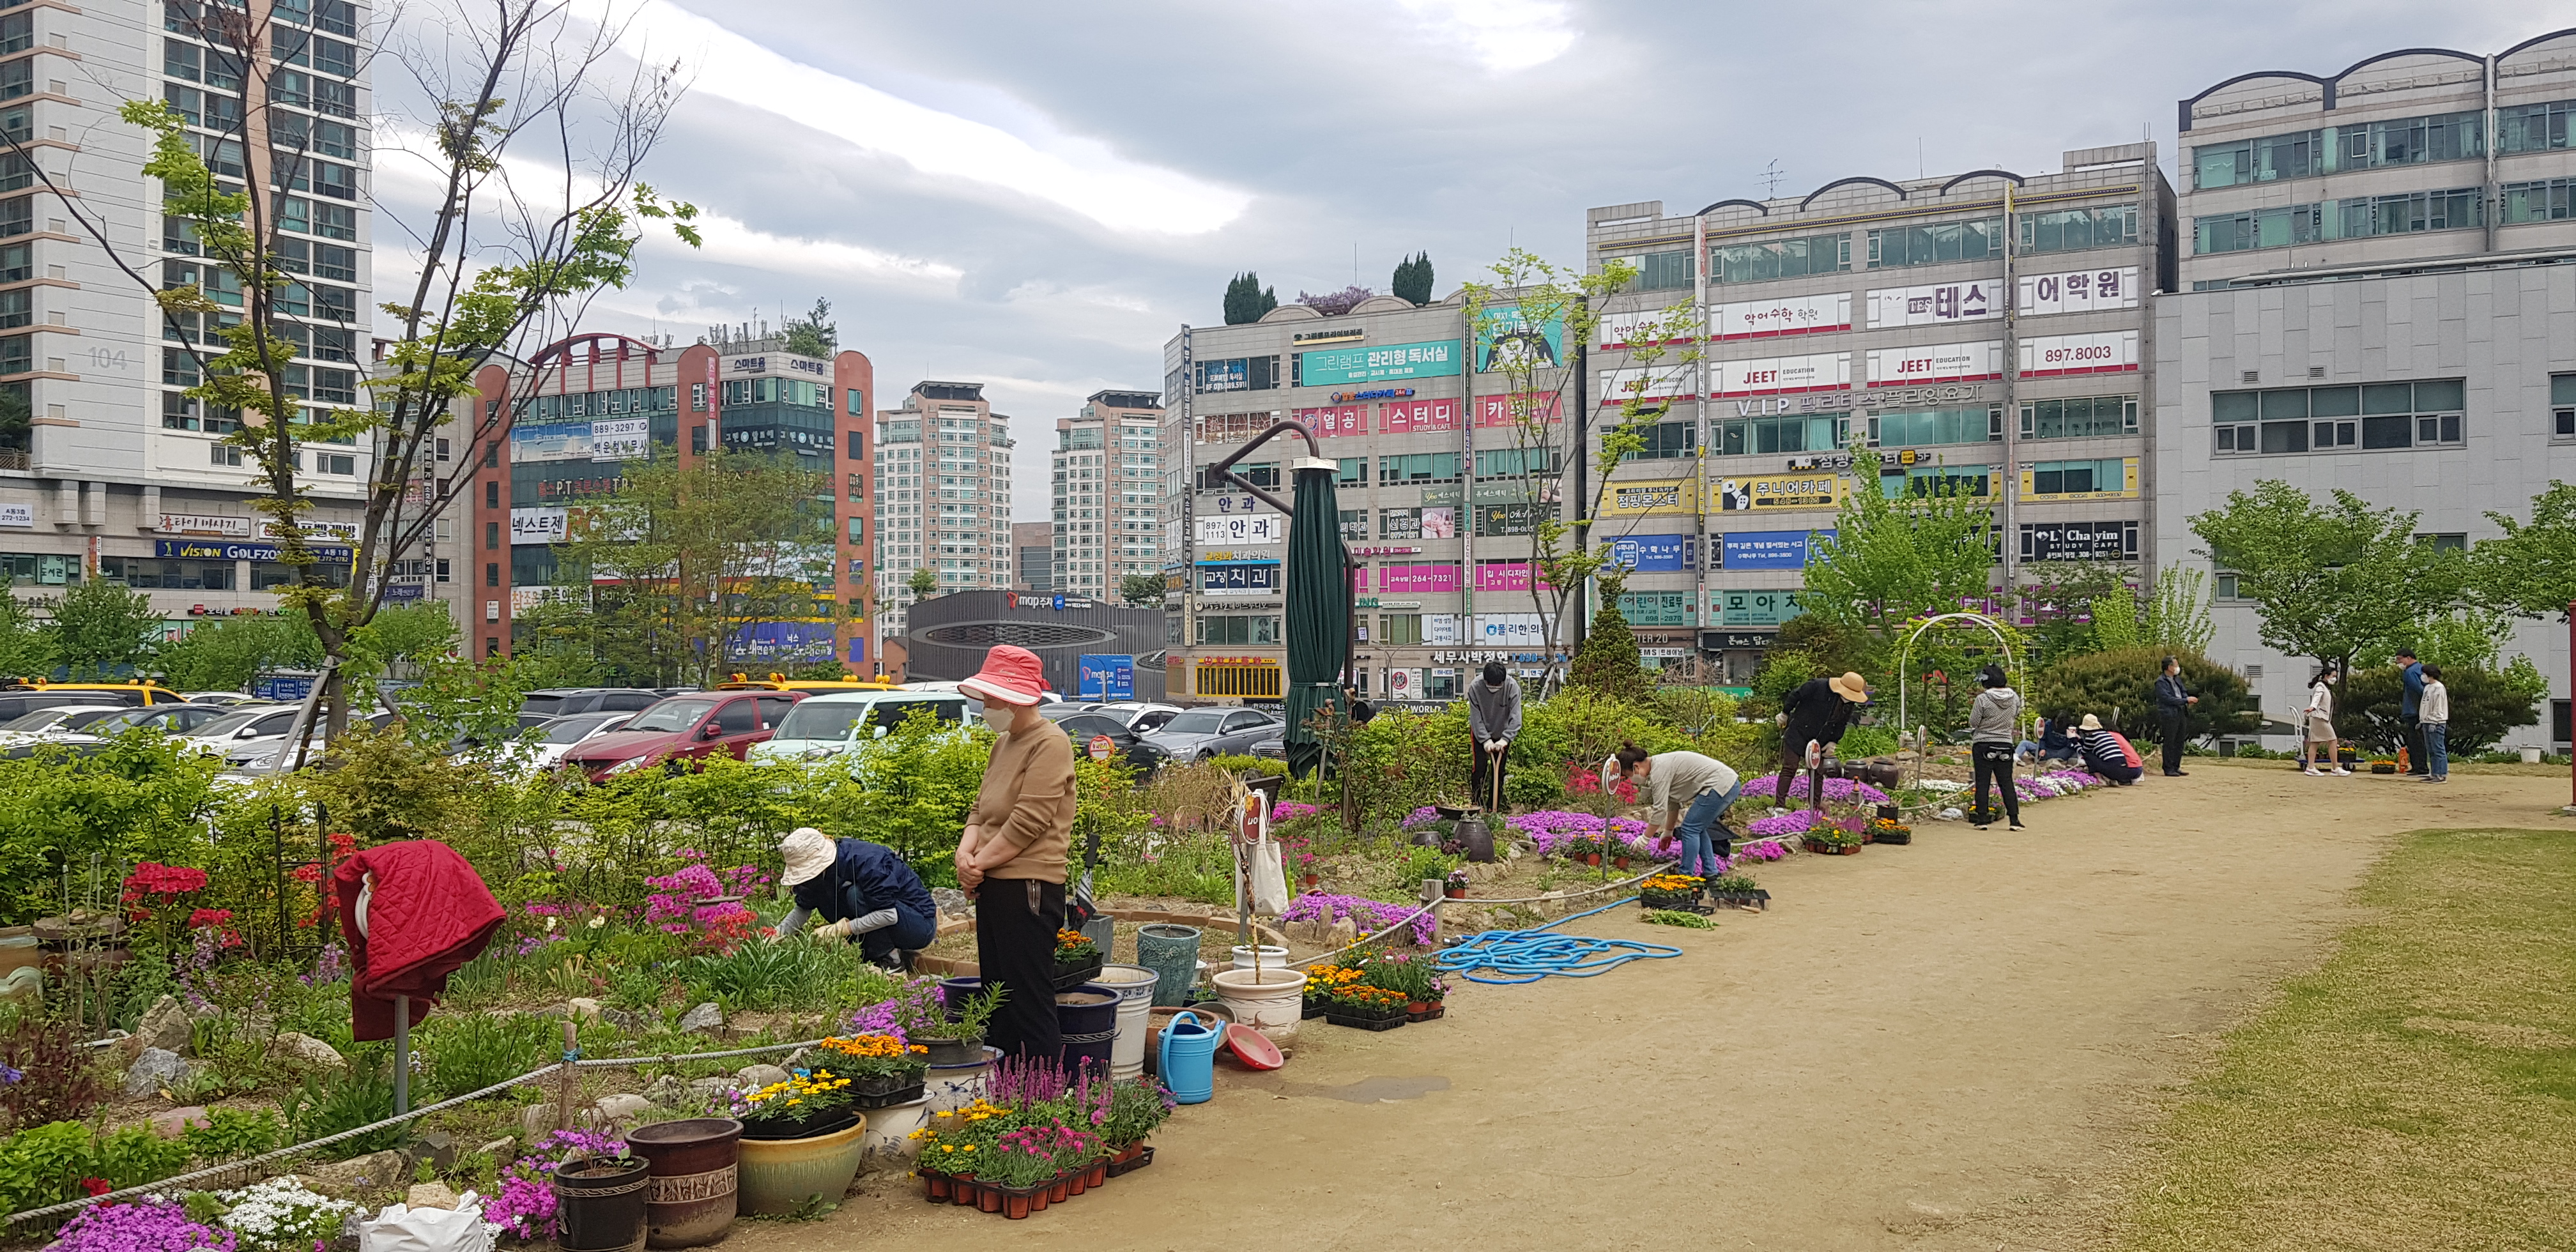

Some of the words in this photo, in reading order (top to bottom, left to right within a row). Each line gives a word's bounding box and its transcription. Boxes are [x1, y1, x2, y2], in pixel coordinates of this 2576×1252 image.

[2037, 271, 2120, 303] 어학원
[1745, 308, 1793, 326] 악어수학
[1797, 309, 1818, 321] 학원
[87, 346, 127, 371] 104
[1315, 353, 1365, 372] 그린램프
[1367, 349, 1407, 367] 관리형
[1408, 345, 1448, 364] 독서실
[2045, 346, 2112, 362] 897.8003
[734, 356, 765, 369] 스마트홈
[790, 359, 824, 376] 스마트홈
[1897, 358, 1933, 373] JEET
[1743, 370, 1777, 385] JEET
[1782, 367, 1815, 375] EDUCATION
[1737, 398, 1790, 417] VIP
[1322, 409, 1356, 430] 열공
[1391, 405, 1450, 425] 스터디
[594, 423, 635, 434] 889-3297
[849, 487, 862, 496] 1470
[1756, 480, 1831, 496] 주니어카페
[1219, 496, 1256, 512] 안과
[1617, 492, 1680, 508] 점핑몬스터
[512, 515, 564, 537] 넥스트젠
[1230, 519, 1269, 539] 안과
[1206, 531, 1225, 539] 1113
[1639, 545, 1681, 554] 수학나무
[1206, 571, 1227, 583] 교정
[1230, 568, 1268, 585] 치과
[1412, 574, 1452, 583] 264-7321
[1508, 569, 1529, 578] 디자인
[1623, 596, 1658, 608] 어린이
[1661, 596, 1683, 608] 진료부
[1498, 623, 1549, 636] 폴리한의
[1656, 633, 1669, 644] 20
